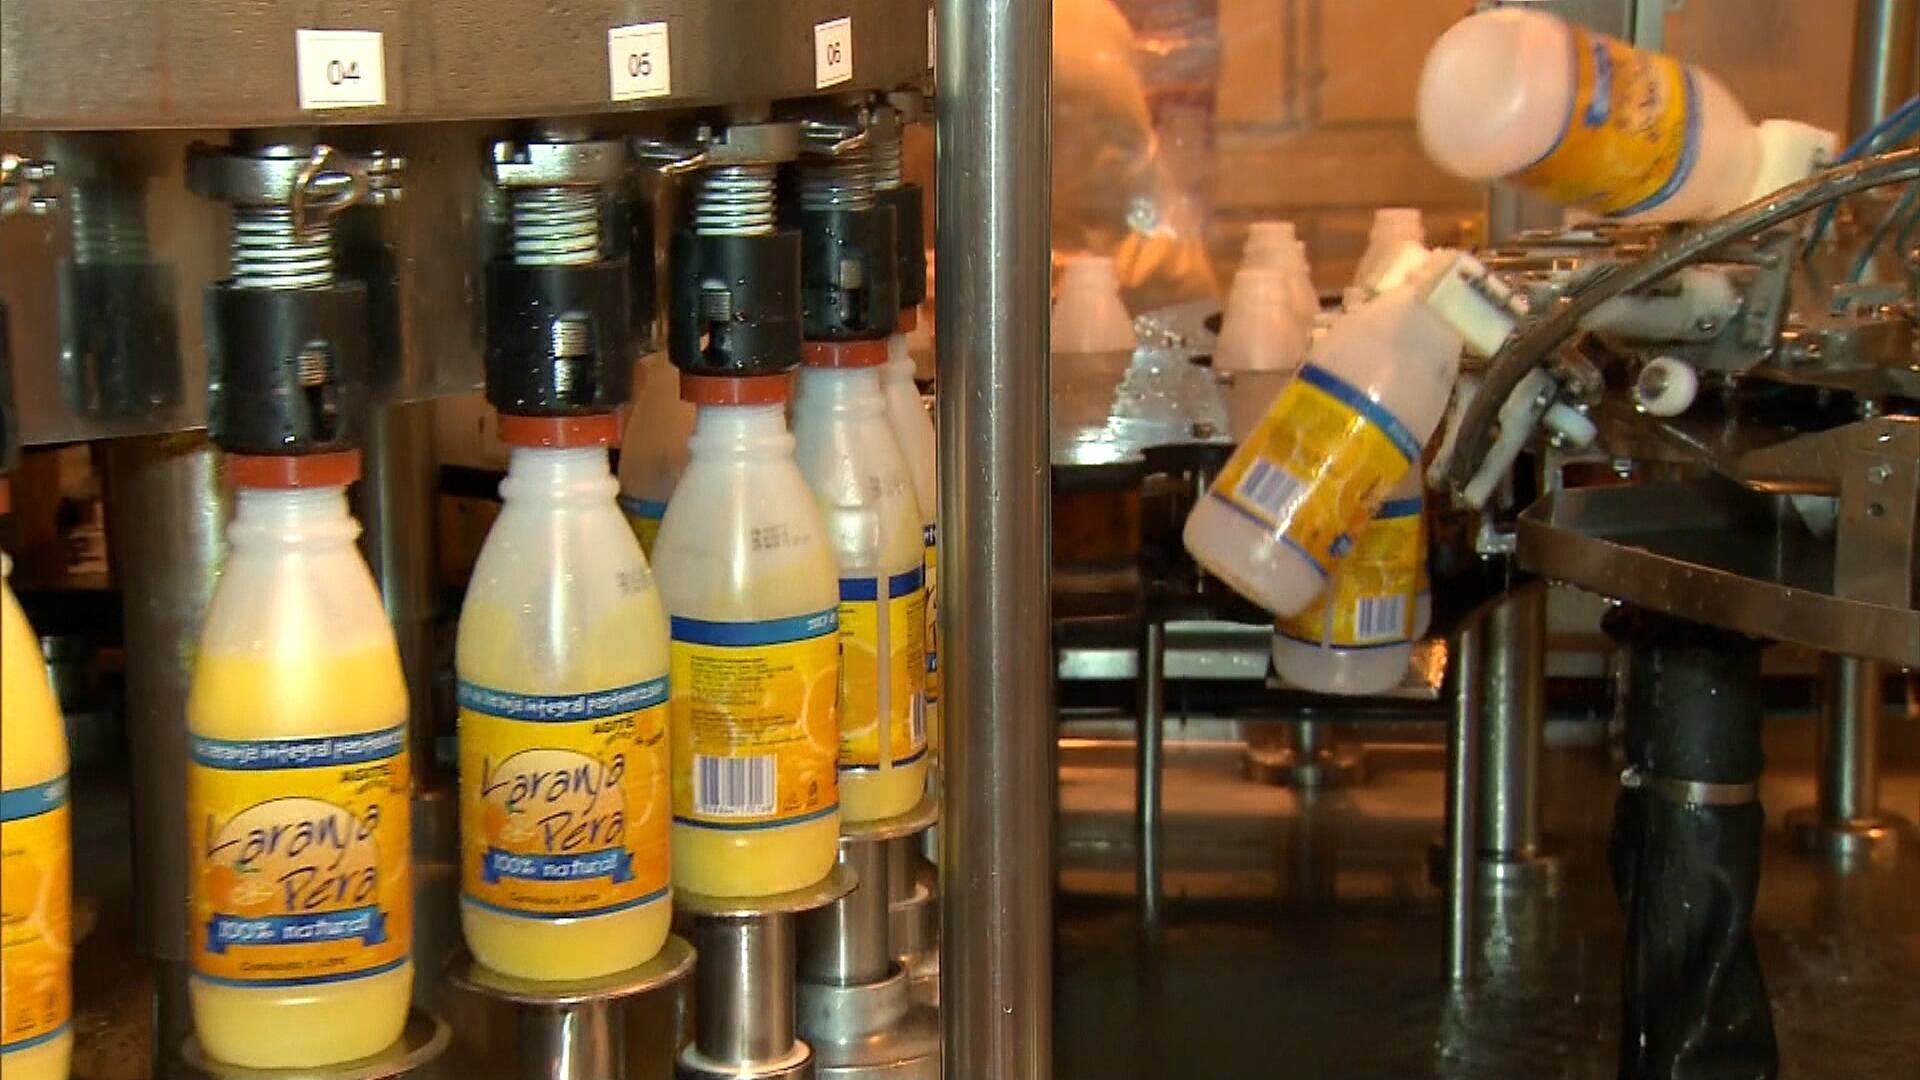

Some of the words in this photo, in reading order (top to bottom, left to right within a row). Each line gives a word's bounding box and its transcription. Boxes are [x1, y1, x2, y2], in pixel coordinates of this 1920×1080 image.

[827, 41, 841, 66] 06
[326, 60, 361, 85] 04
[482, 753, 625, 817] Laranja
[205, 804, 379, 871] Laranja
[494, 853, 536, 874] 100%
[542, 853, 618, 877] natural
[218, 920, 276, 940] 100%
[282, 912, 371, 939] natural
